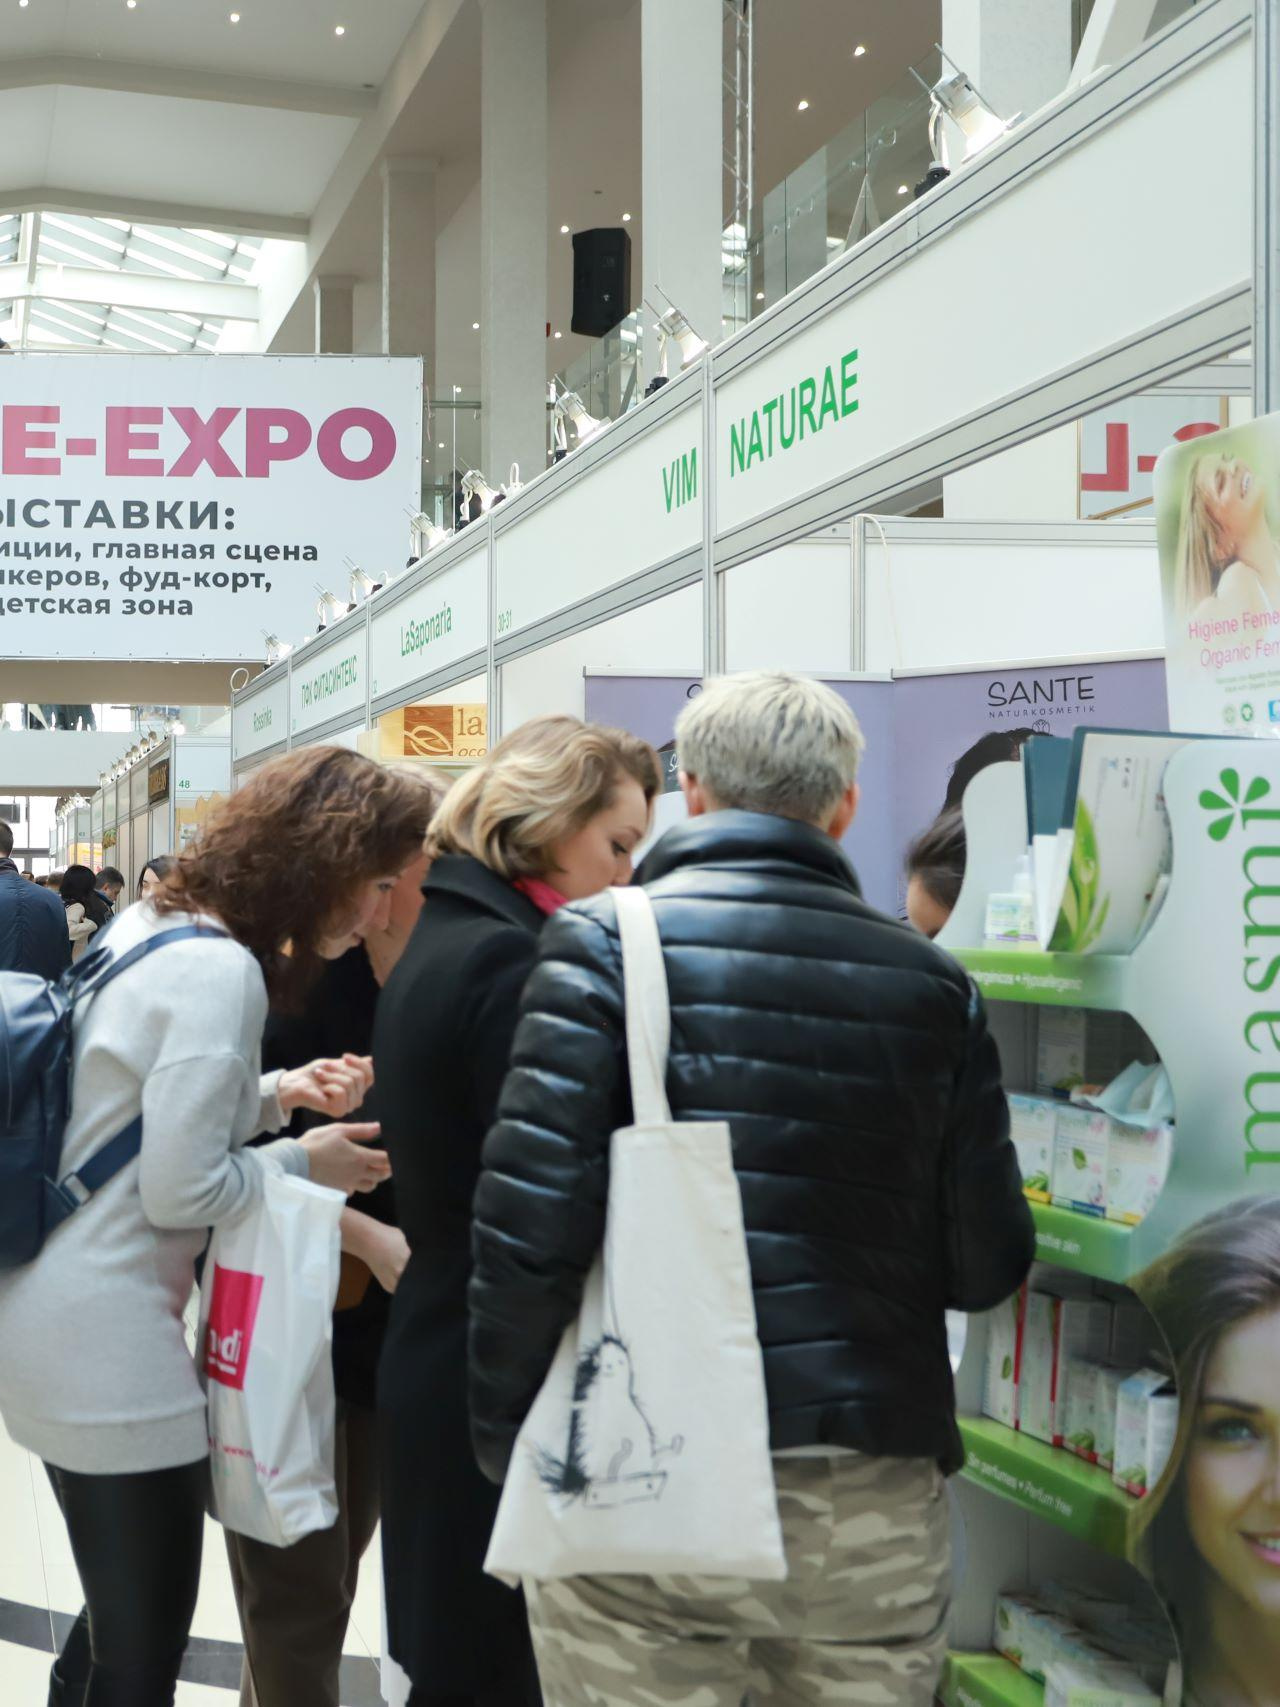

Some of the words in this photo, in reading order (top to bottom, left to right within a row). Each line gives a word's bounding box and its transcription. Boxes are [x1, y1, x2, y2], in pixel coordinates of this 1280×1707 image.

[662, 447, 698, 513] VIM
[730, 349, 860, 479] NATURAE
[92, 542, 215, 560] главная
[226, 543, 318, 564] сцена
[119, 565, 272, 593] фуд-корт,
[121, 598, 193, 616] зона
[400, 601, 453, 657] LaSaponaria
[1188, 618, 1239, 641] Higiene
[987, 676, 1095, 707] SANTE
[457, 708, 485, 737] la
[989, 705, 1095, 718] NATURKOSMETIK
[178, 780, 190, 789] 48
